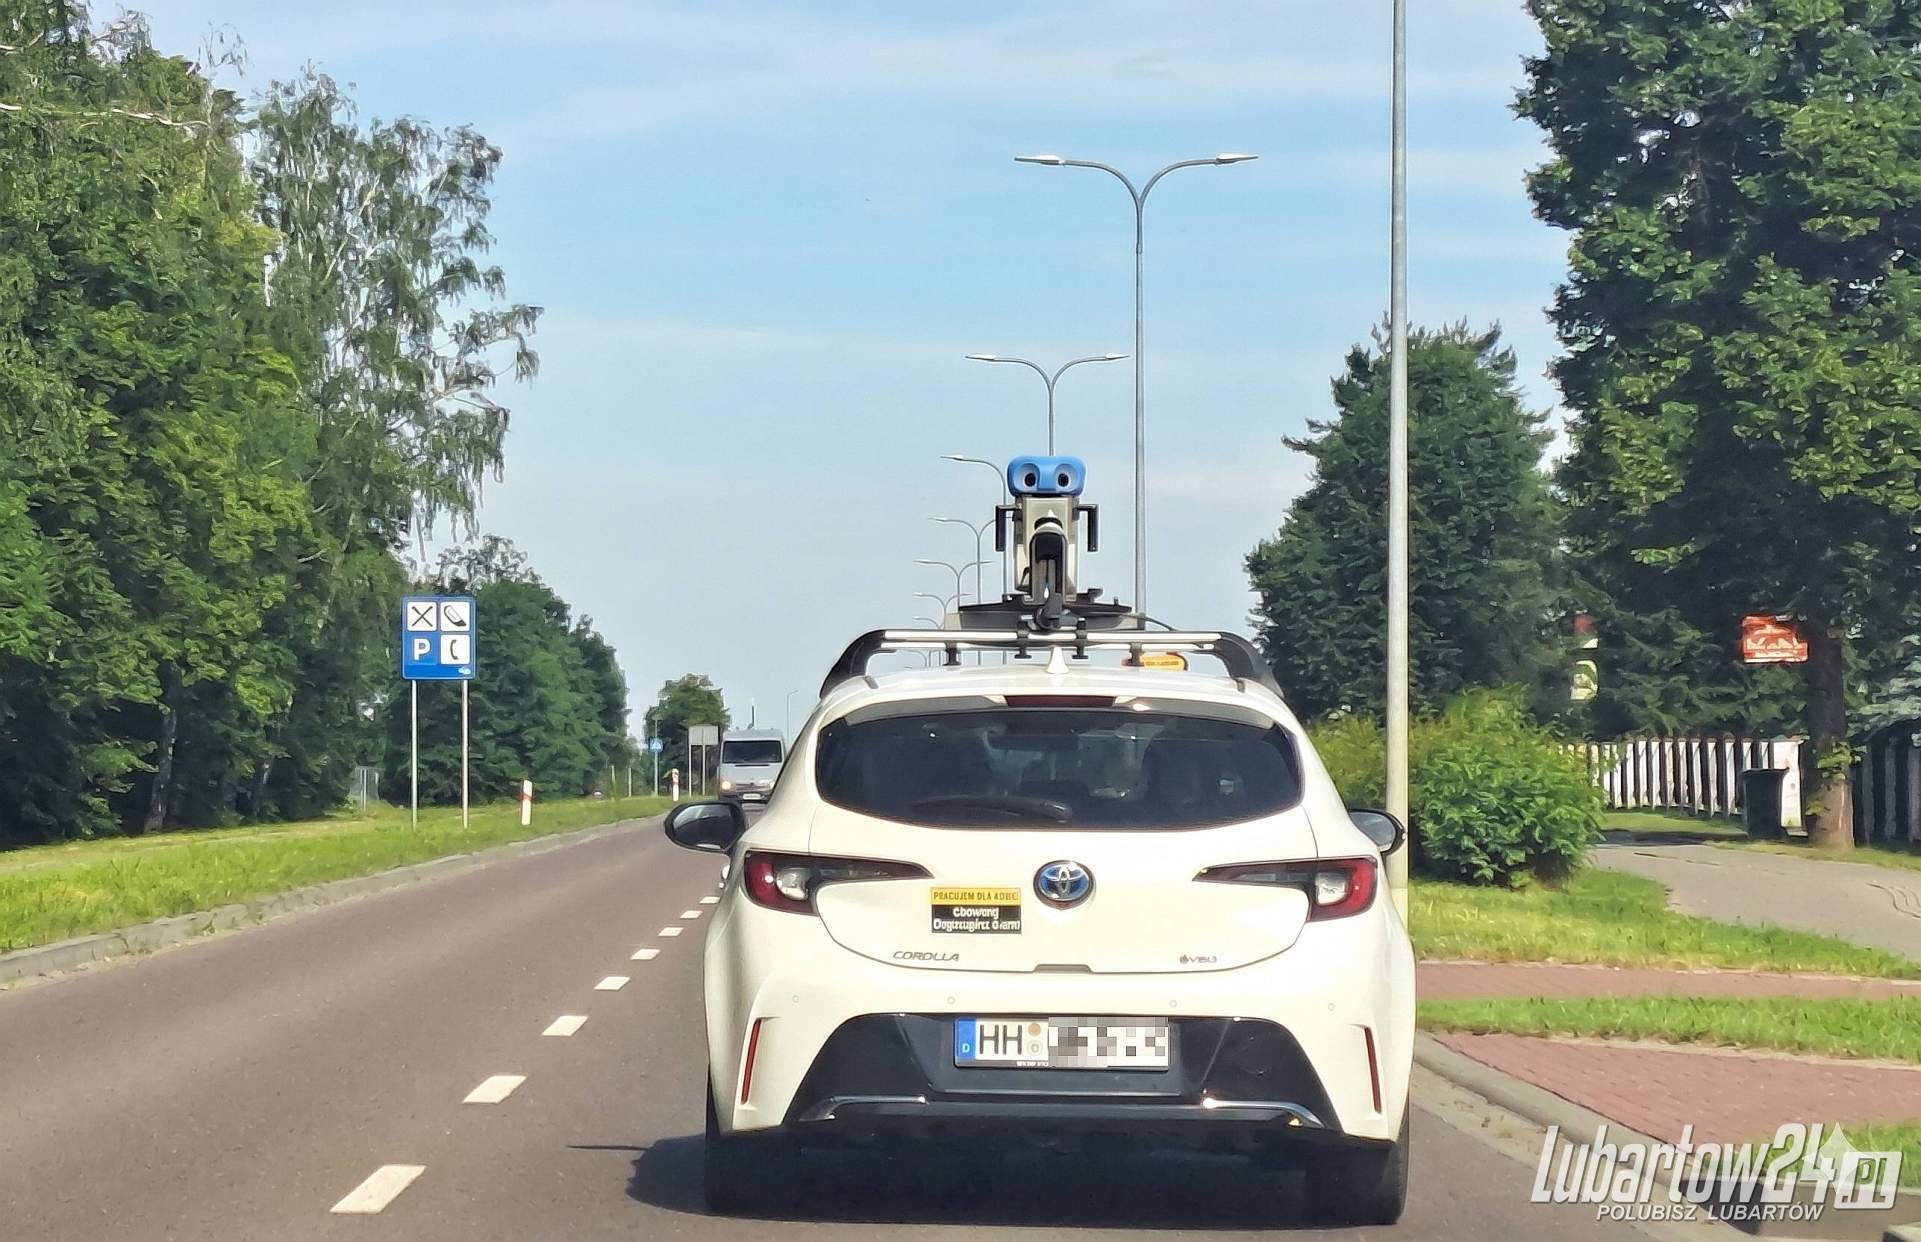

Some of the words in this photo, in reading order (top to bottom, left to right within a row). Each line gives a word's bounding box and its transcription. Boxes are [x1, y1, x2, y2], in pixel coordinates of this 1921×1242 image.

[413, 638, 431, 660] P
[977, 891, 992, 900] DLA
[893, 951, 960, 962] COROLLA
[979, 1024, 1023, 1055] HH
